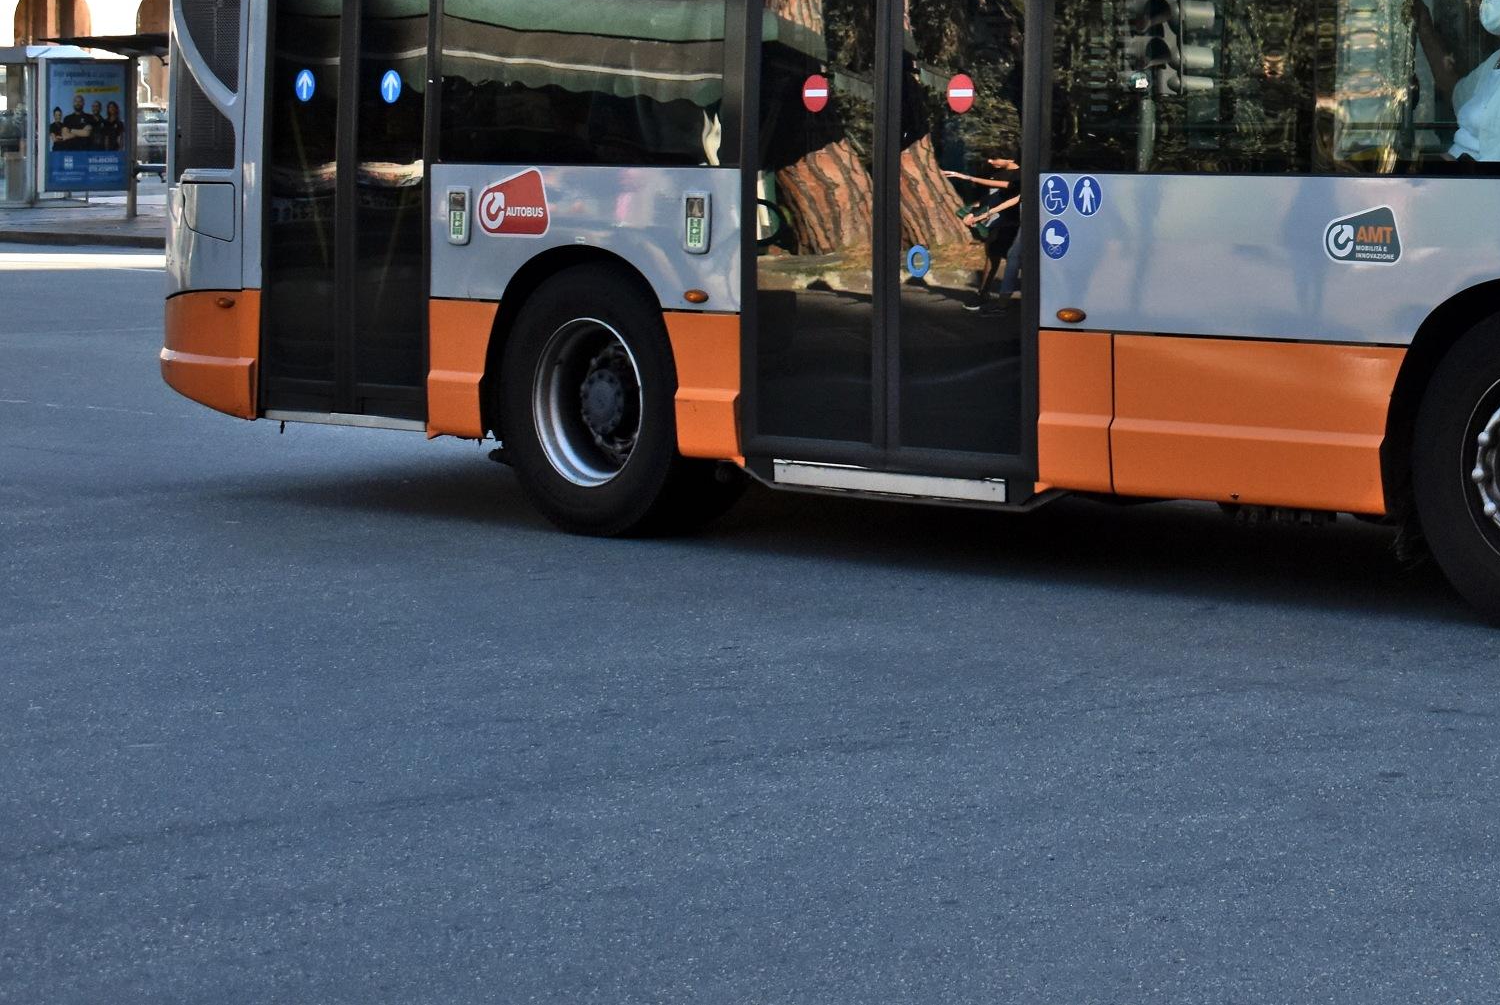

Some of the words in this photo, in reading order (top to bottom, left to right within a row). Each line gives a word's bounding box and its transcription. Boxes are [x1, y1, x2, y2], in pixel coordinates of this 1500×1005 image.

[505, 207, 544, 218] AUTOBUS
[1356, 226, 1393, 244] AMT
[1355, 252, 1395, 260] INNOVAZIONE
